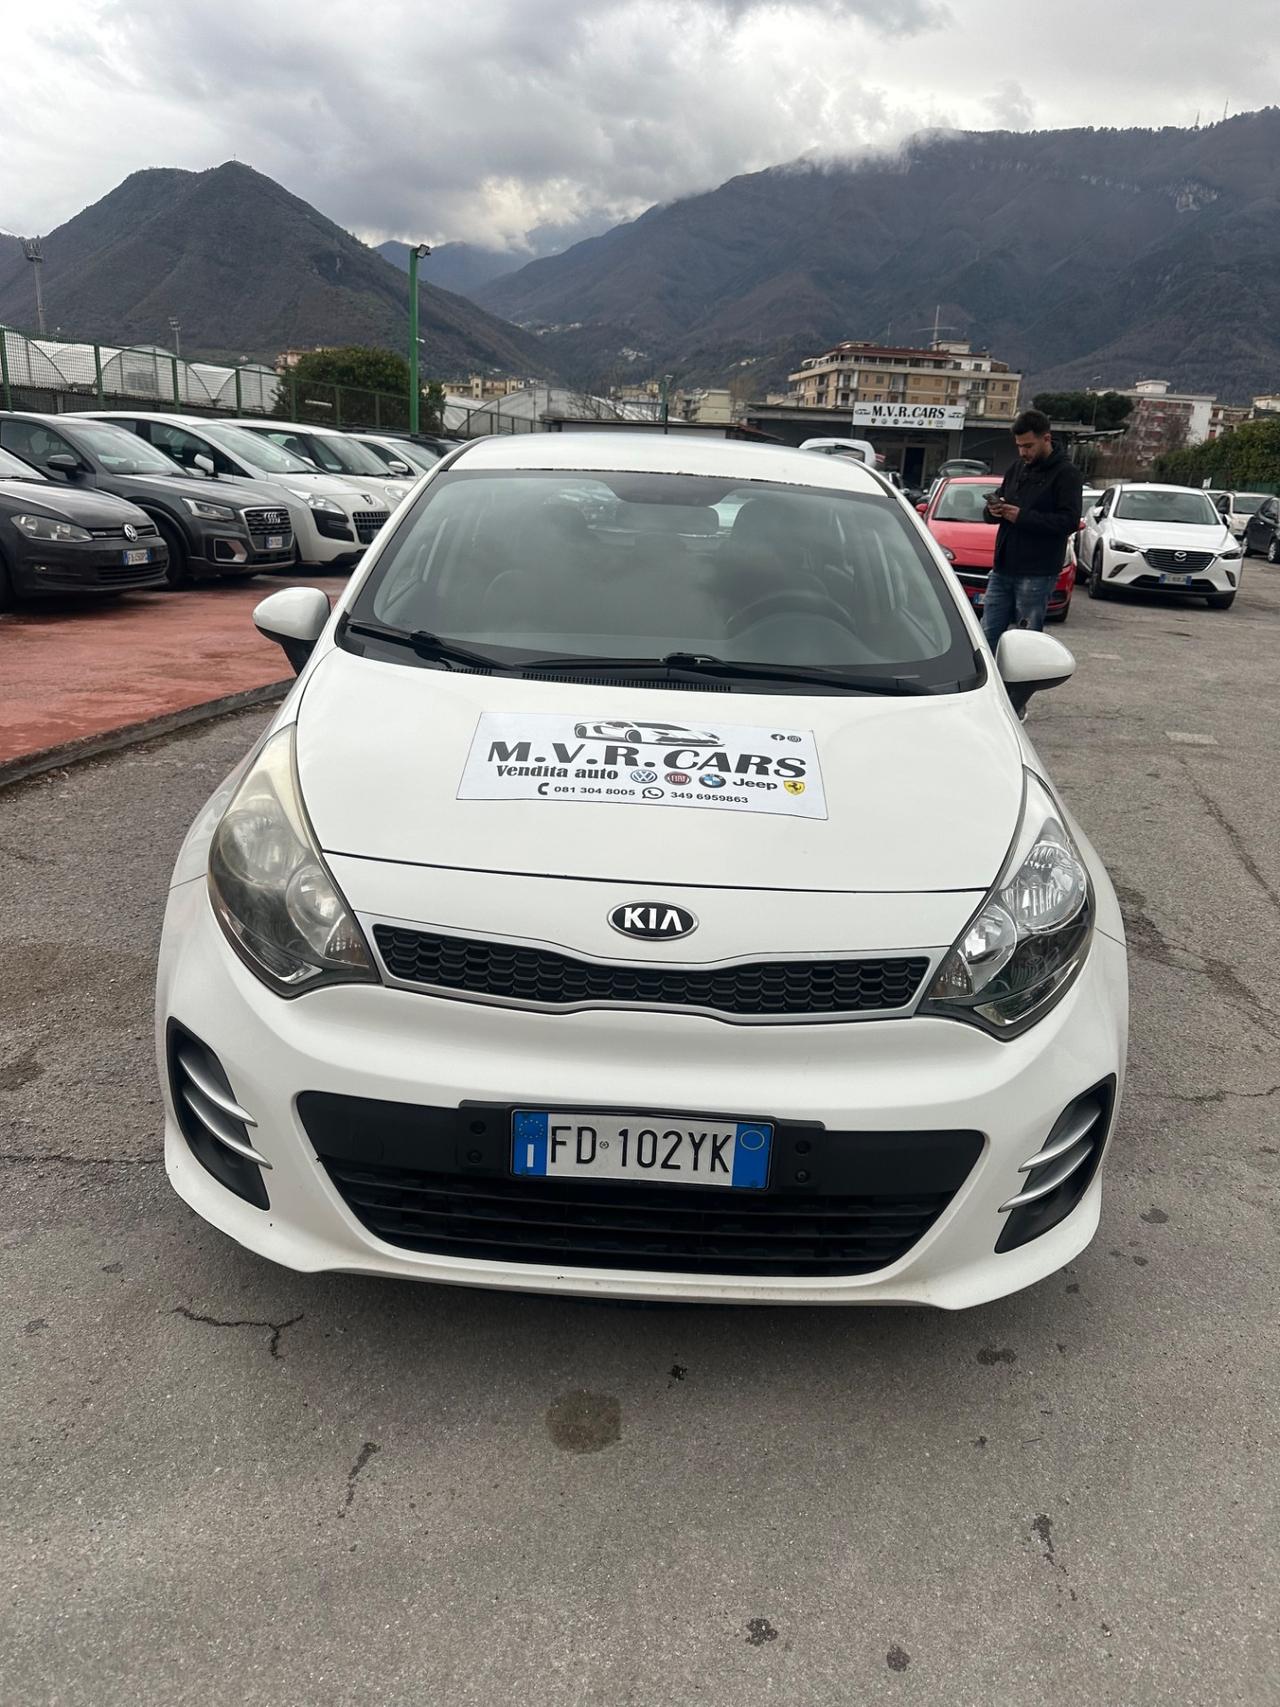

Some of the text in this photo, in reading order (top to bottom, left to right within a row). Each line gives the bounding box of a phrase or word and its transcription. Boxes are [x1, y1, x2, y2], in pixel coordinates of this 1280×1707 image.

[496, 765, 619, 780] Vendita auto
[732, 778, 778, 790] Jeep
[605, 788, 636, 796] 8005
[670, 791, 749, 803] 349 6959863
[623, 907, 683, 932] KIA
[550, 1125, 733, 1174] FD 102YK
